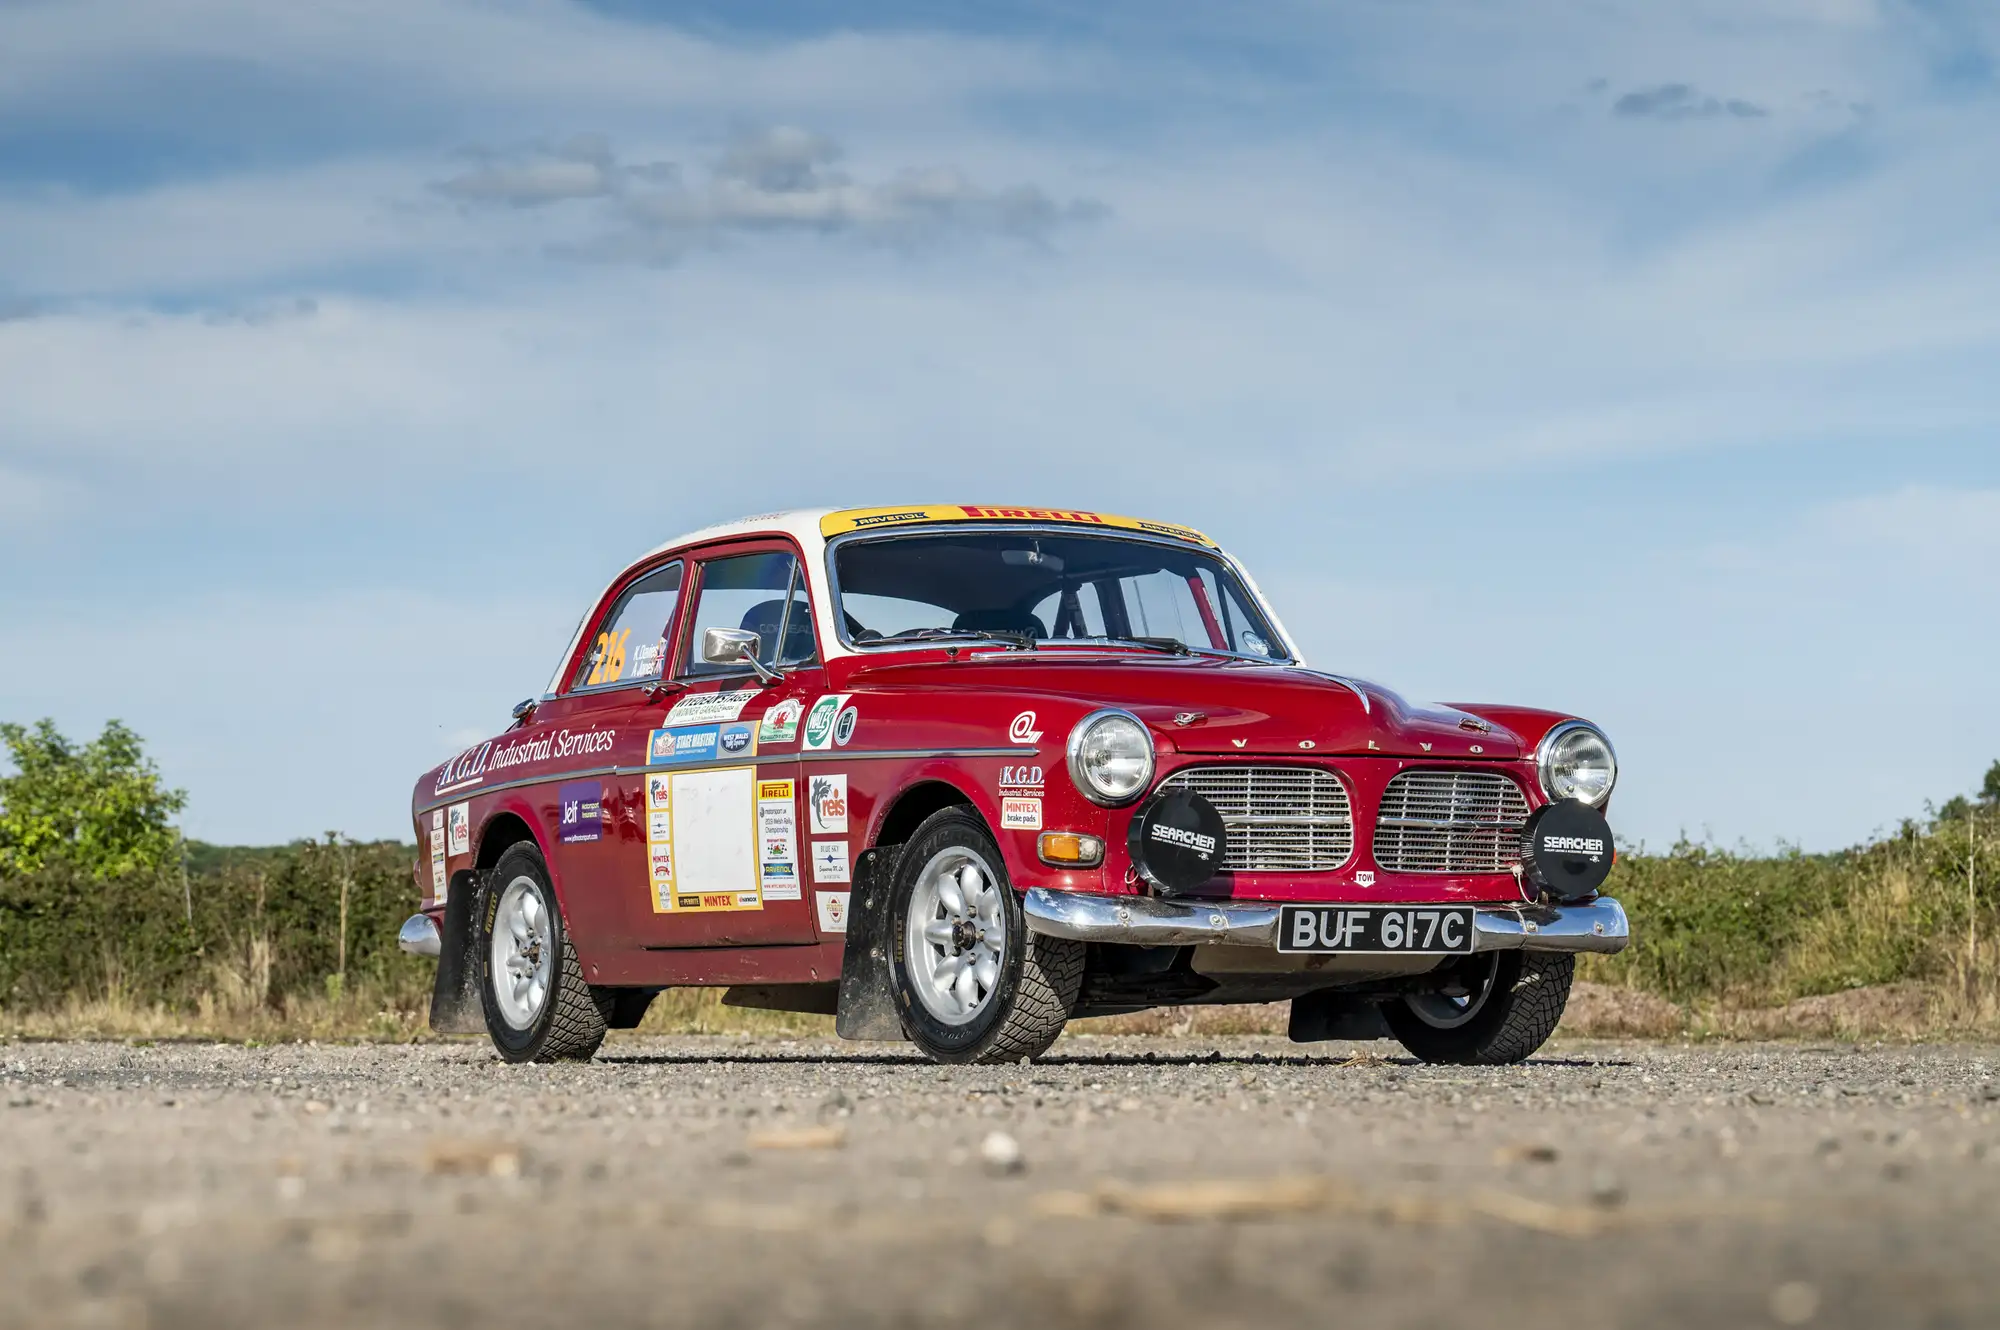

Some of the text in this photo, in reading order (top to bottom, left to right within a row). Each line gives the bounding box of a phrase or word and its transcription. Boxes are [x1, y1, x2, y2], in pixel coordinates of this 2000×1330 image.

[858, 513, 920, 525] RAVENOL
[957, 505, 1103, 523] PIRELLI
[587, 627, 632, 686] 216
[487, 730, 556, 772] Industrial
[553, 724, 615, 758] Services
[692, 732, 717, 748] MASTERS
[1002, 766, 1045, 784] K.G.D.
[655, 784, 667, 800] reis
[762, 784, 789, 798] PIRELLI
[998, 788, 1045, 797] Industrial Services
[822, 788, 845, 817] reis
[1006, 803, 1037, 813] MINTEX
[562, 800, 578, 824] Jelf
[1007, 814, 1036, 824] brake pads
[455, 816, 467, 840] reis
[1151, 823, 1216, 850] SEARCHER
[1543, 836, 1603, 851] SEARCHER
[652, 855, 669, 863] MINTEX
[1358, 873, 1373, 882] TOW
[704, 896, 732, 907] MINTEX
[1292, 910, 1465, 948] BUF 617C
